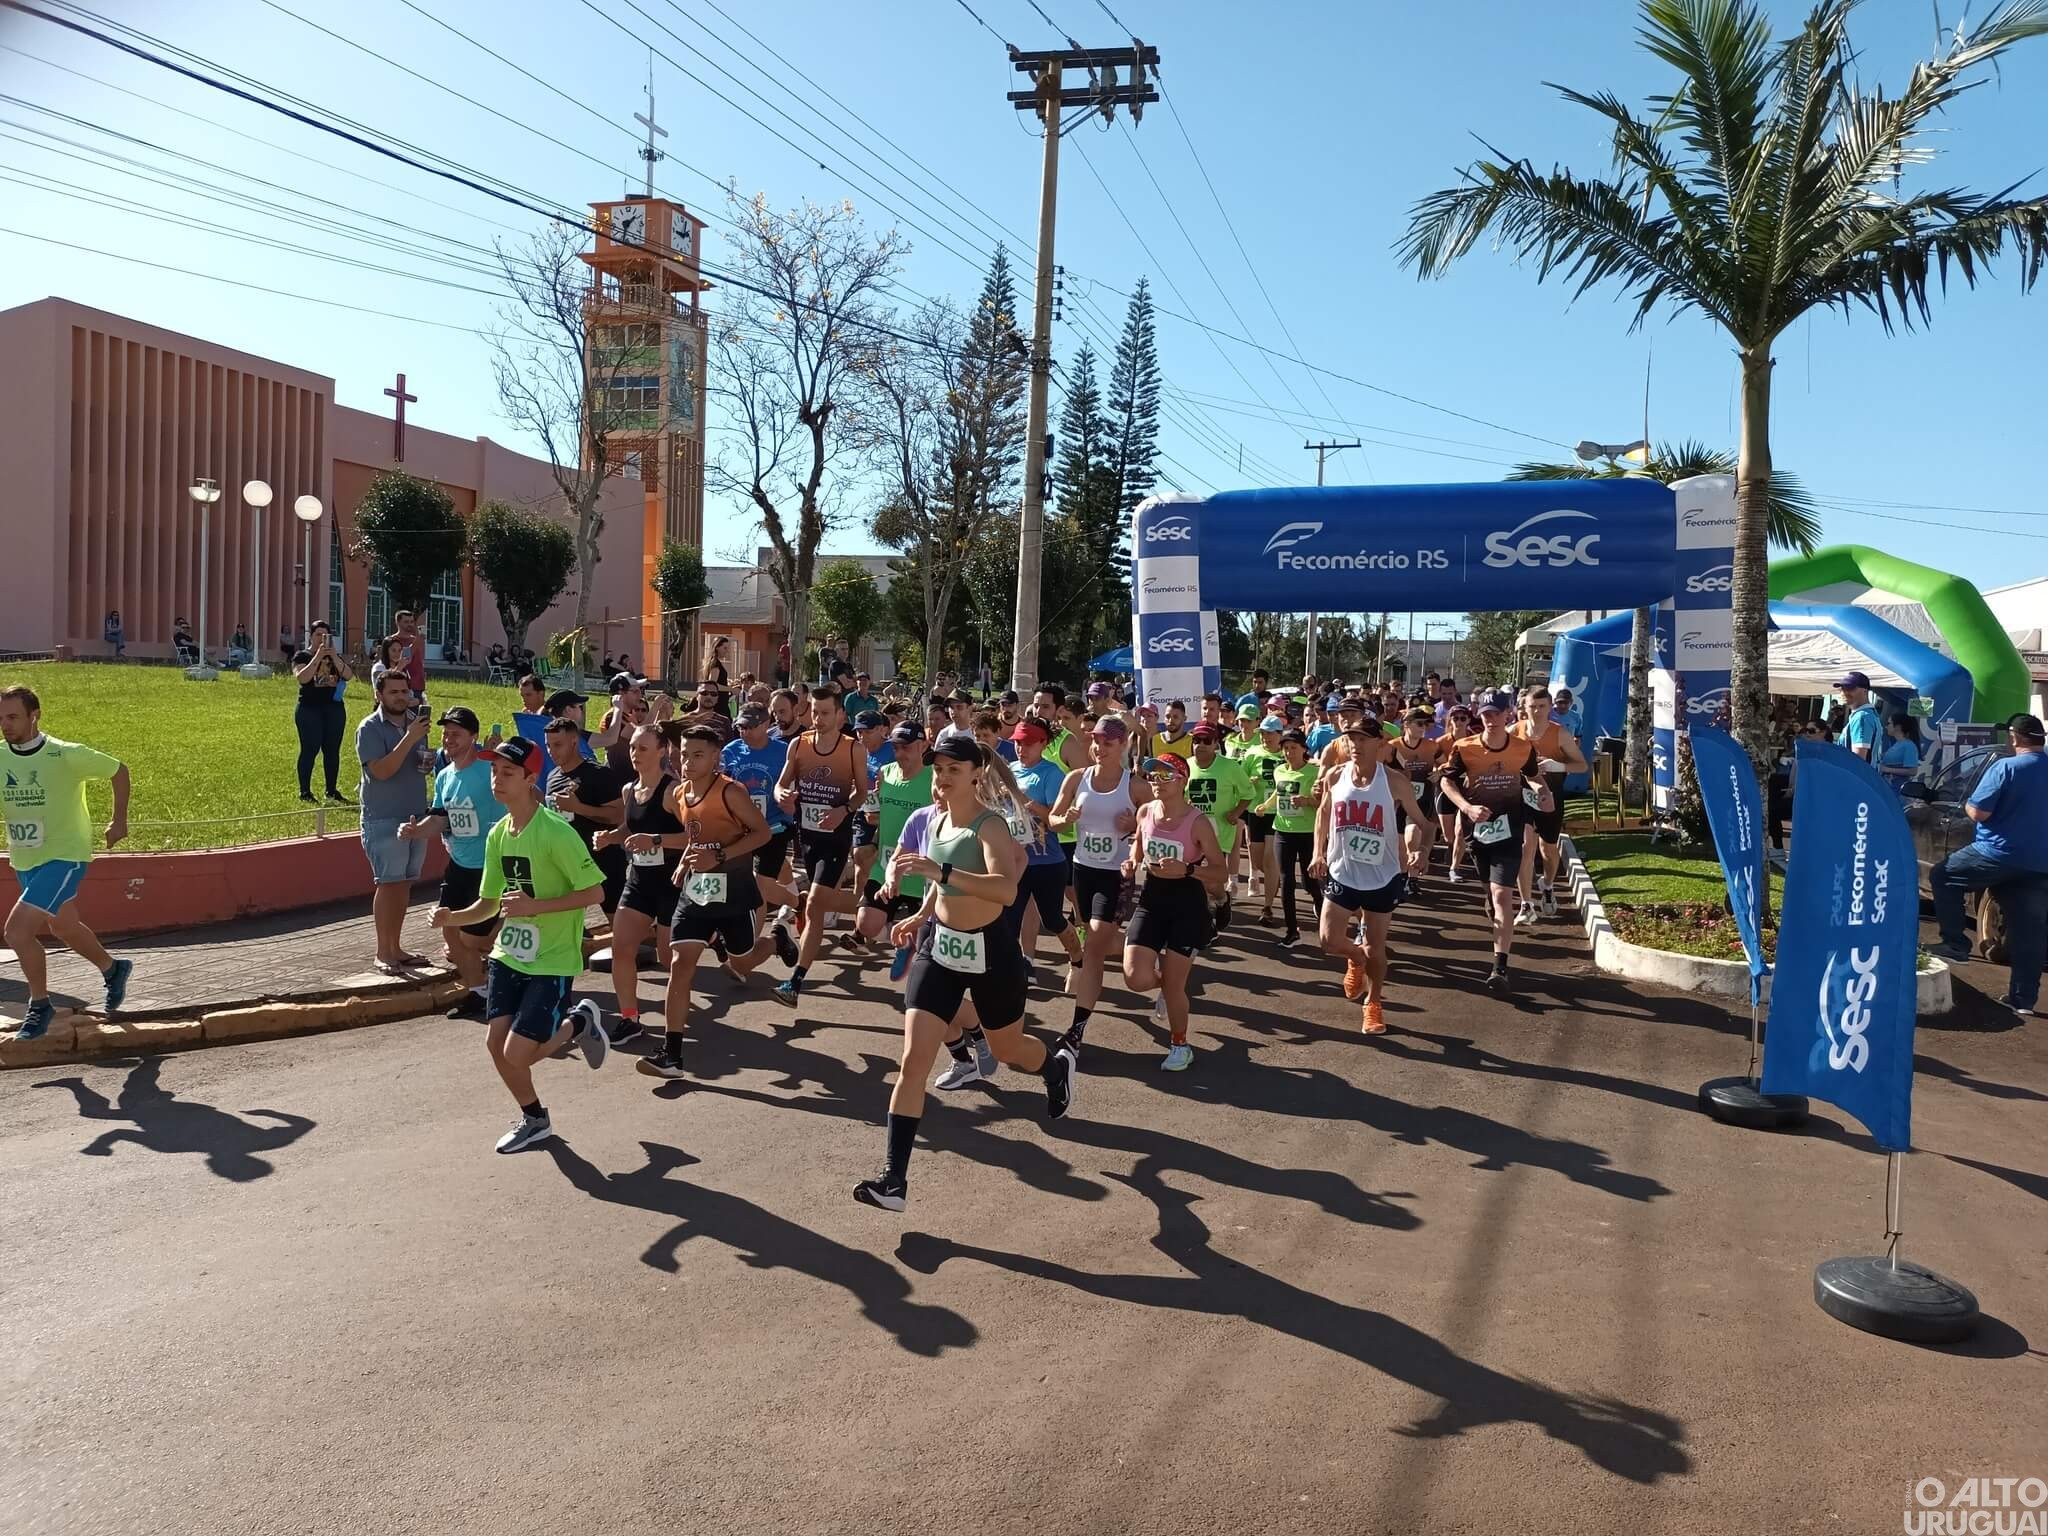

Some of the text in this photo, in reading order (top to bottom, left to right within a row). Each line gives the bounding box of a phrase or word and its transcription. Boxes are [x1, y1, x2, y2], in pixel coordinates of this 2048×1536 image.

[1145, 522, 1192, 542] Sesc
[1483, 526, 1600, 568] Sesc
[1277, 549, 1449, 569] Fecomércio RS
[1144, 584, 1197, 594] Fecomércio RS
[1686, 573, 1735, 593] Ses
[1148, 634, 1195, 653] Sesc
[814, 782, 840, 793] Forma
[451, 813, 472, 828] 381
[9, 823, 38, 841] 602
[1083, 836, 1113, 854] 458
[1147, 840, 1178, 858] 630
[1349, 836, 1380, 855] 473
[1848, 802, 1869, 926] Fecomércio
[1871, 859, 1889, 924] Senac
[501, 926, 533, 950] 678
[938, 933, 977, 961] 564
[1825, 945, 1880, 1074] Sesc
